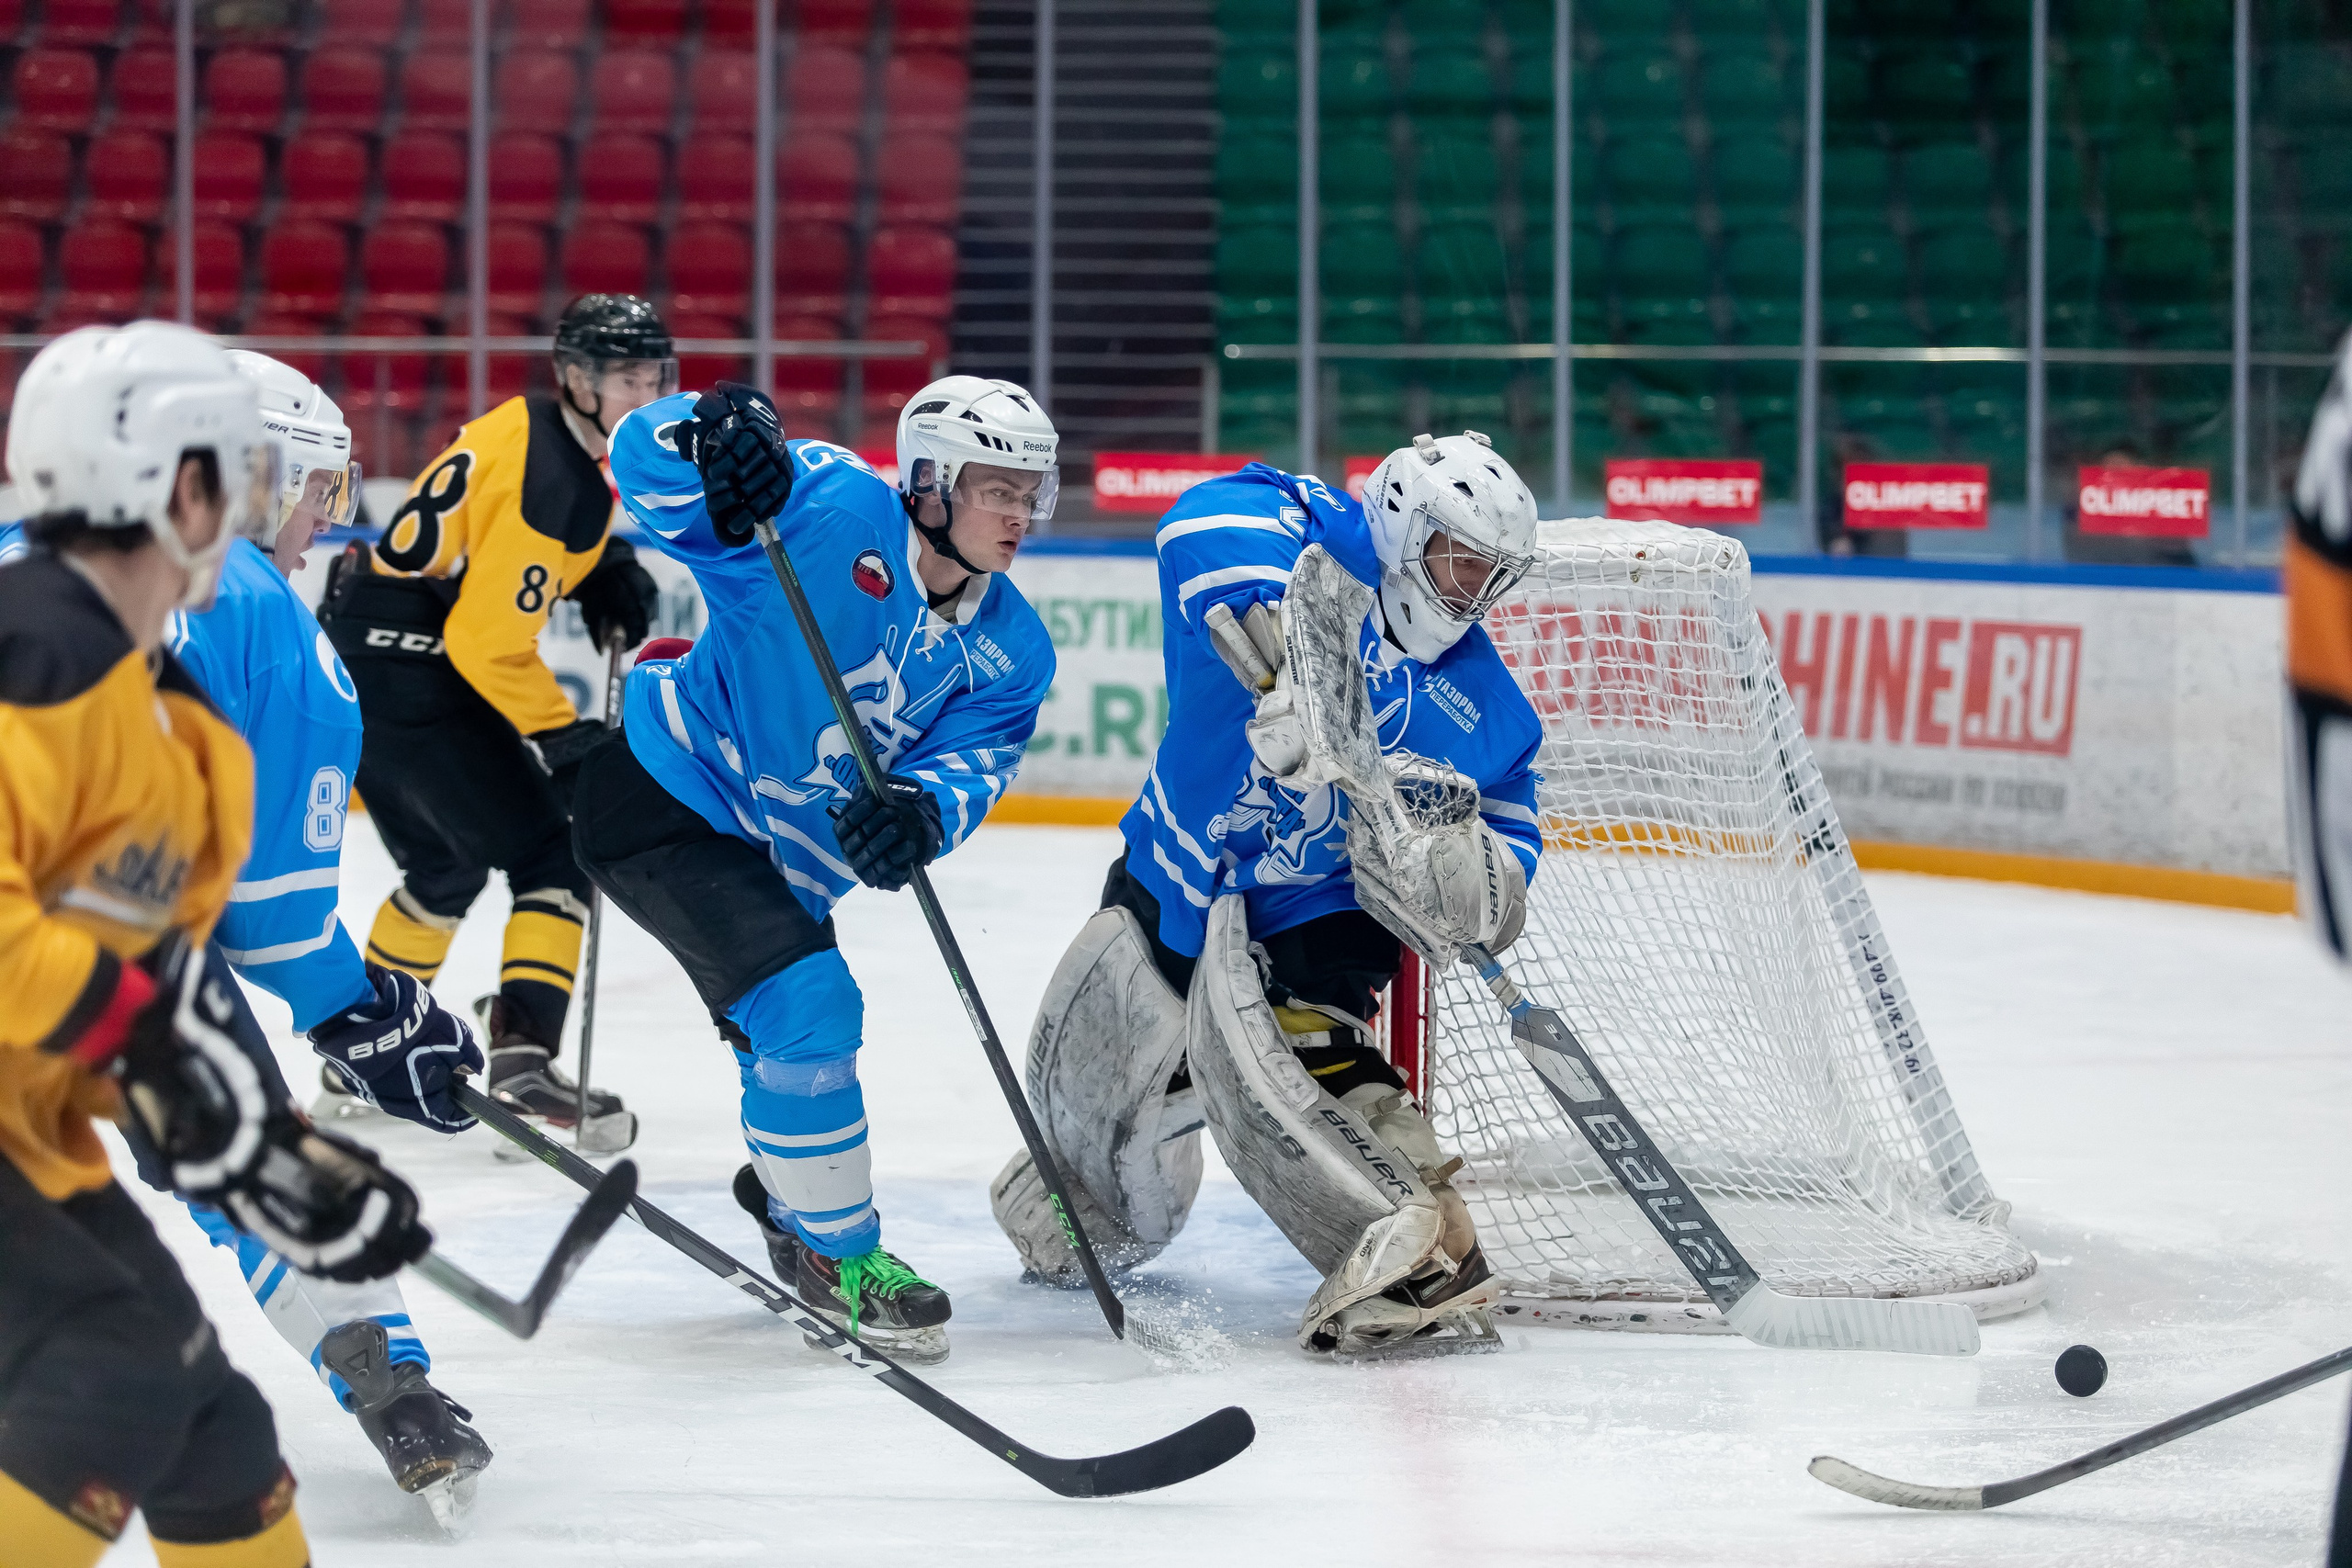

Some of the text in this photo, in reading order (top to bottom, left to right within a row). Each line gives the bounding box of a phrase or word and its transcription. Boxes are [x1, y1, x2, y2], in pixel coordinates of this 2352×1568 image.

[918, 423, 939, 431] Reebok
[1023, 440, 1052, 453] Reebok
[377, 451, 474, 574] 8
[514, 563, 562, 618] 8
[1285, 635, 1300, 685] SUPREME
[1430, 690, 1475, 733] ПЕРЕРАБОТКА
[1436, 677, 1482, 725] ГАЗПРОМ
[303, 765, 346, 852] 8
[888, 784, 918, 793] CM
[1481, 832, 1499, 926] BAUER
[347, 980, 430, 1061] BAUE
[1318, 1108, 1415, 1196] BAUER
[1050, 1193, 1080, 1247] CCM
[723, 1266, 892, 1377] CCM
